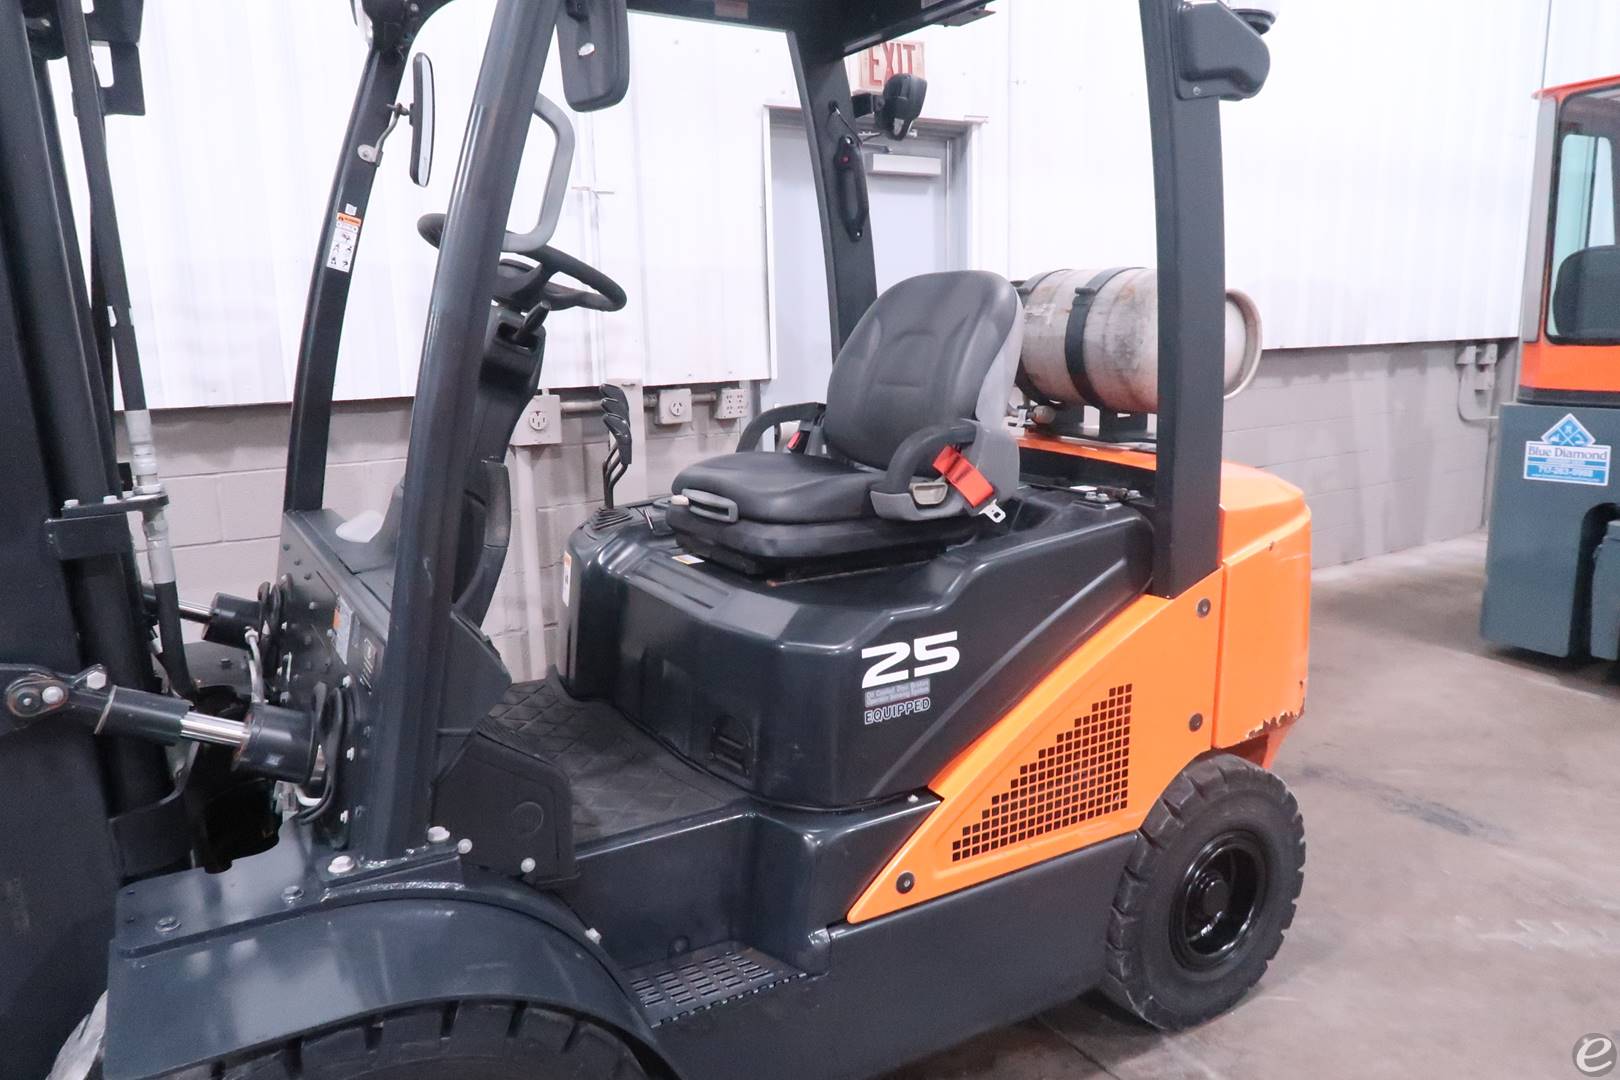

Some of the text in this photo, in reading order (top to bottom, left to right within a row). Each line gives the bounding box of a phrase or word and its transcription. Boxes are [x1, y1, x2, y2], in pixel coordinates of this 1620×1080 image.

[868, 42, 916, 86] EXIT
[1527, 445, 1608, 461] Blue Diamond
[861, 630, 960, 689] 25
[864, 697, 931, 725] EQUIPPED
